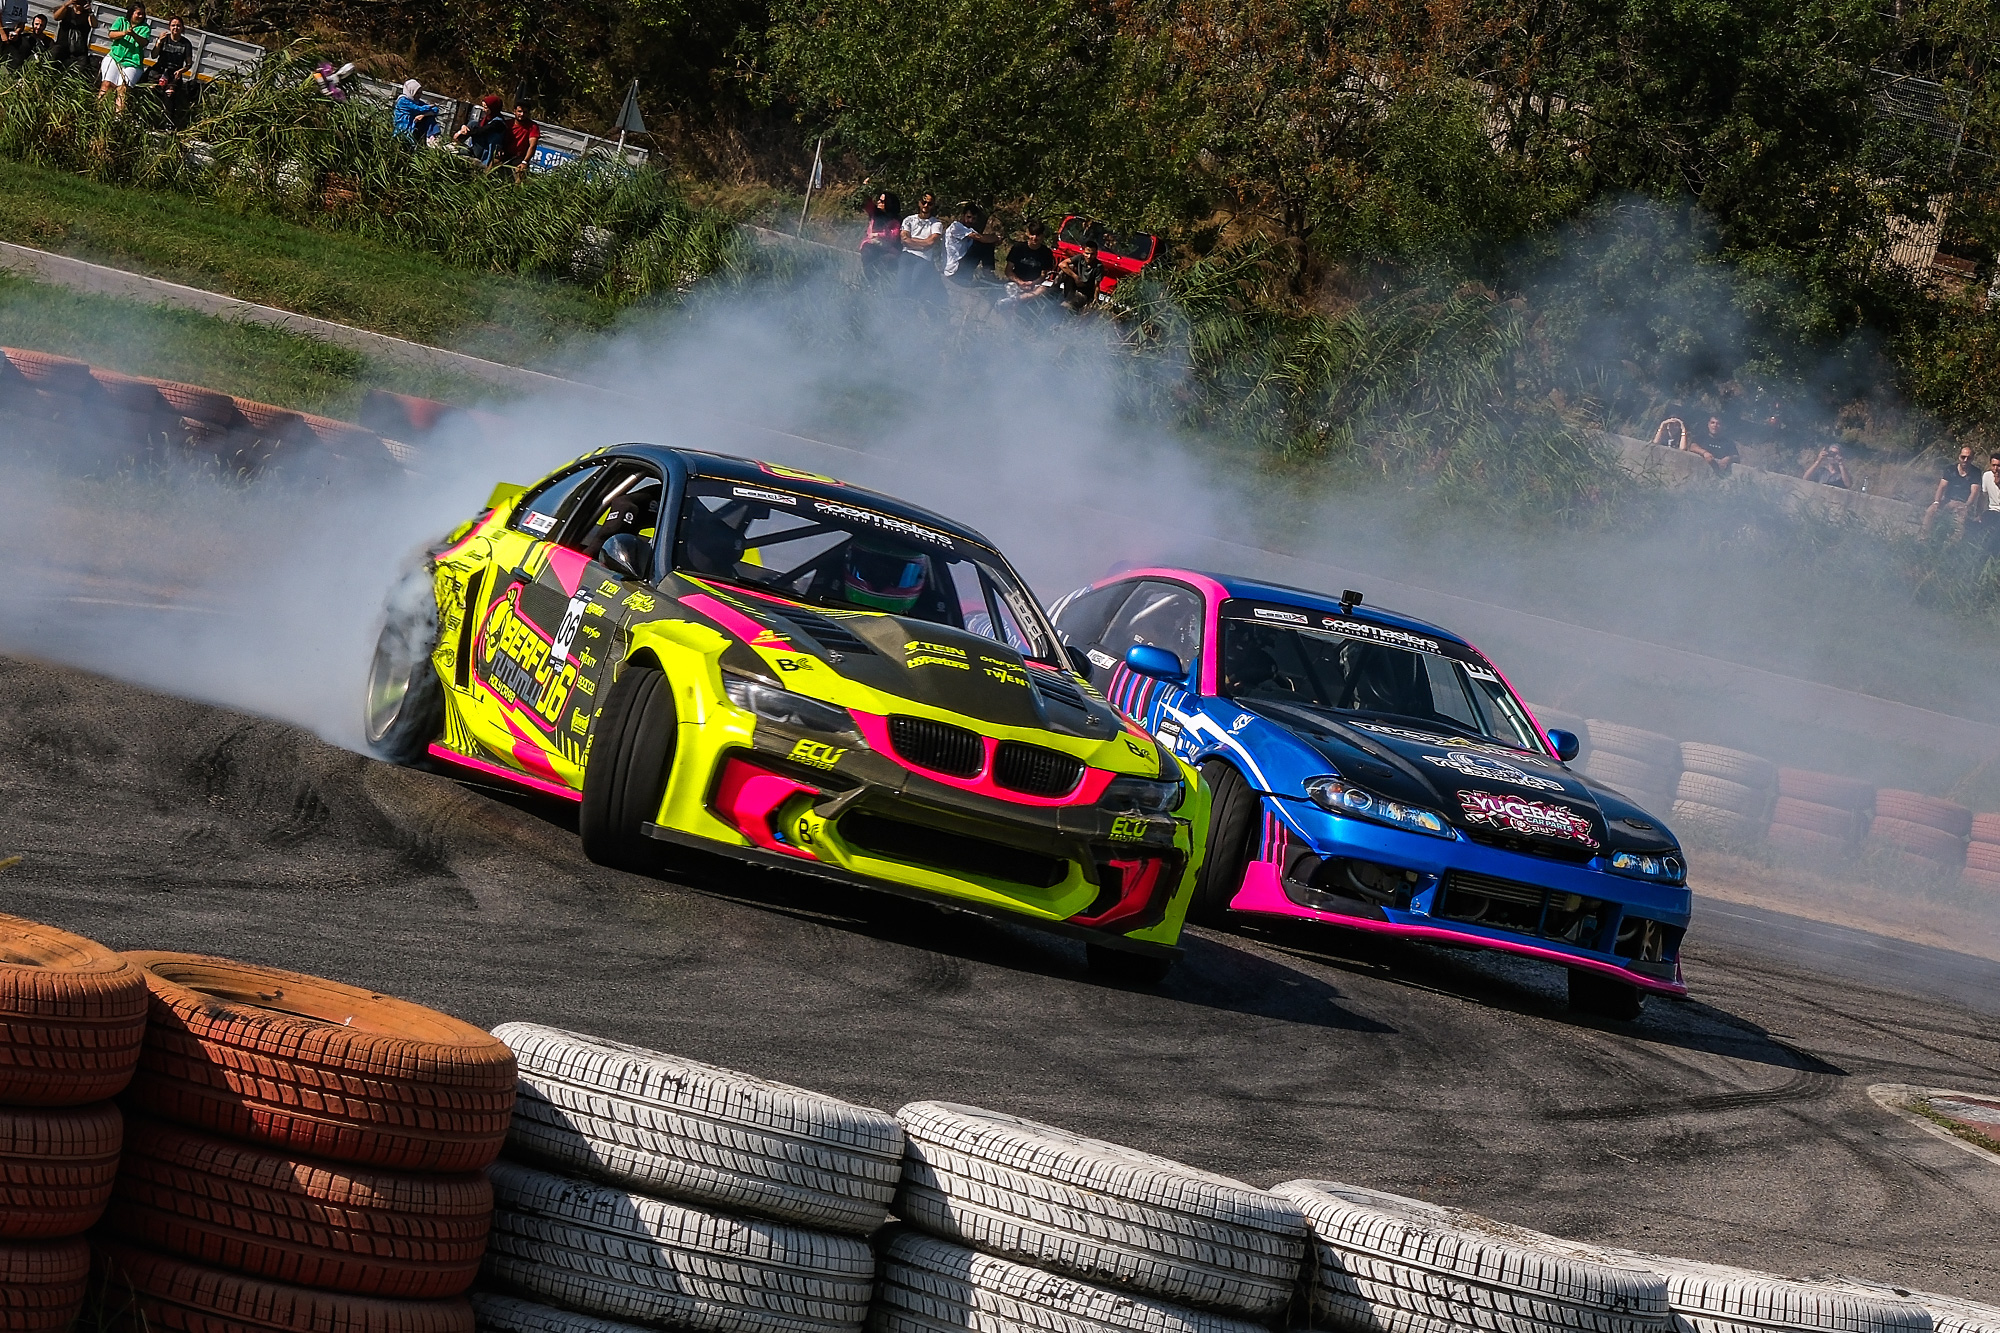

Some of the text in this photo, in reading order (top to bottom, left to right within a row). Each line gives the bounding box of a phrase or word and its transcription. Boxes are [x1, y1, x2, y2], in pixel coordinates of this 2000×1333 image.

[557, 611, 580, 648] 06
[792, 738, 849, 764] ECU
[1111, 816, 1151, 838] ECU
[1526, 816, 1546, 829] CAR
[1546, 820, 1573, 832] PARTS
